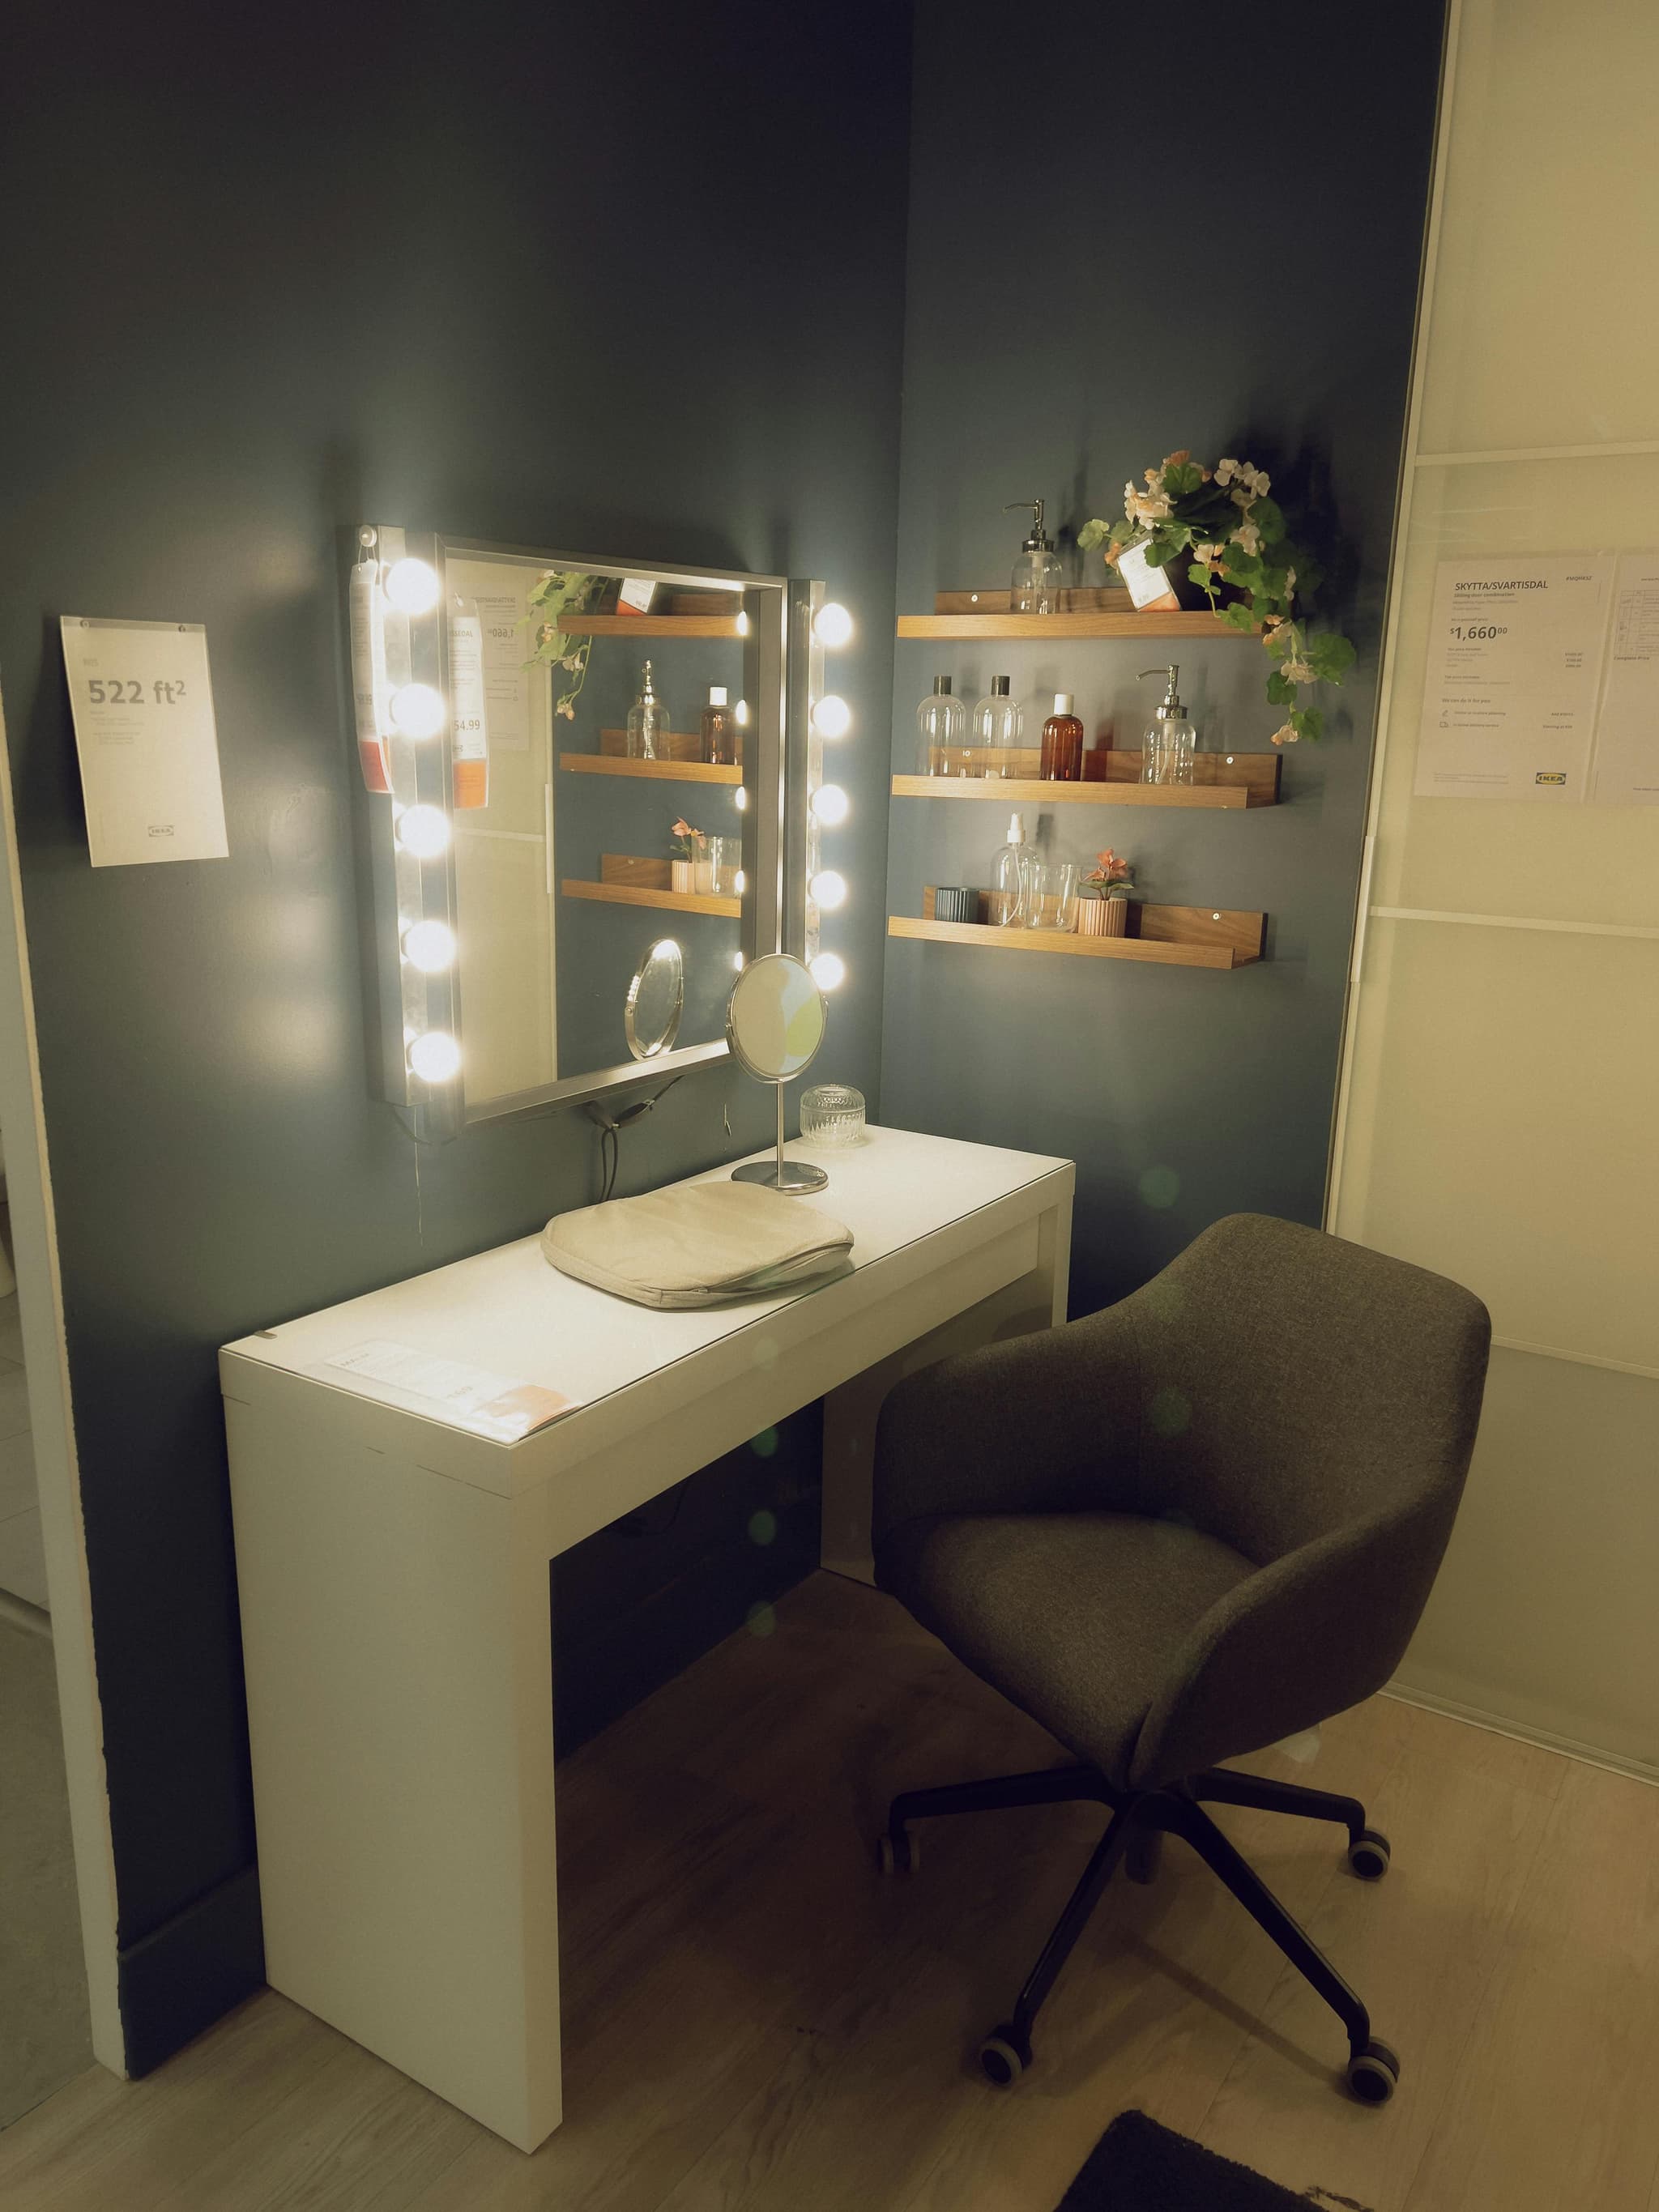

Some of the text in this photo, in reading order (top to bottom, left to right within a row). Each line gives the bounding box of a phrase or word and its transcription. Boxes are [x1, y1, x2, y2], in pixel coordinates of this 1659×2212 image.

[1455, 579, 1549, 591] SKYTTA/SVARTISDAL
[87, 679, 145, 705] 522
[453, 719, 480, 731] 54.99
